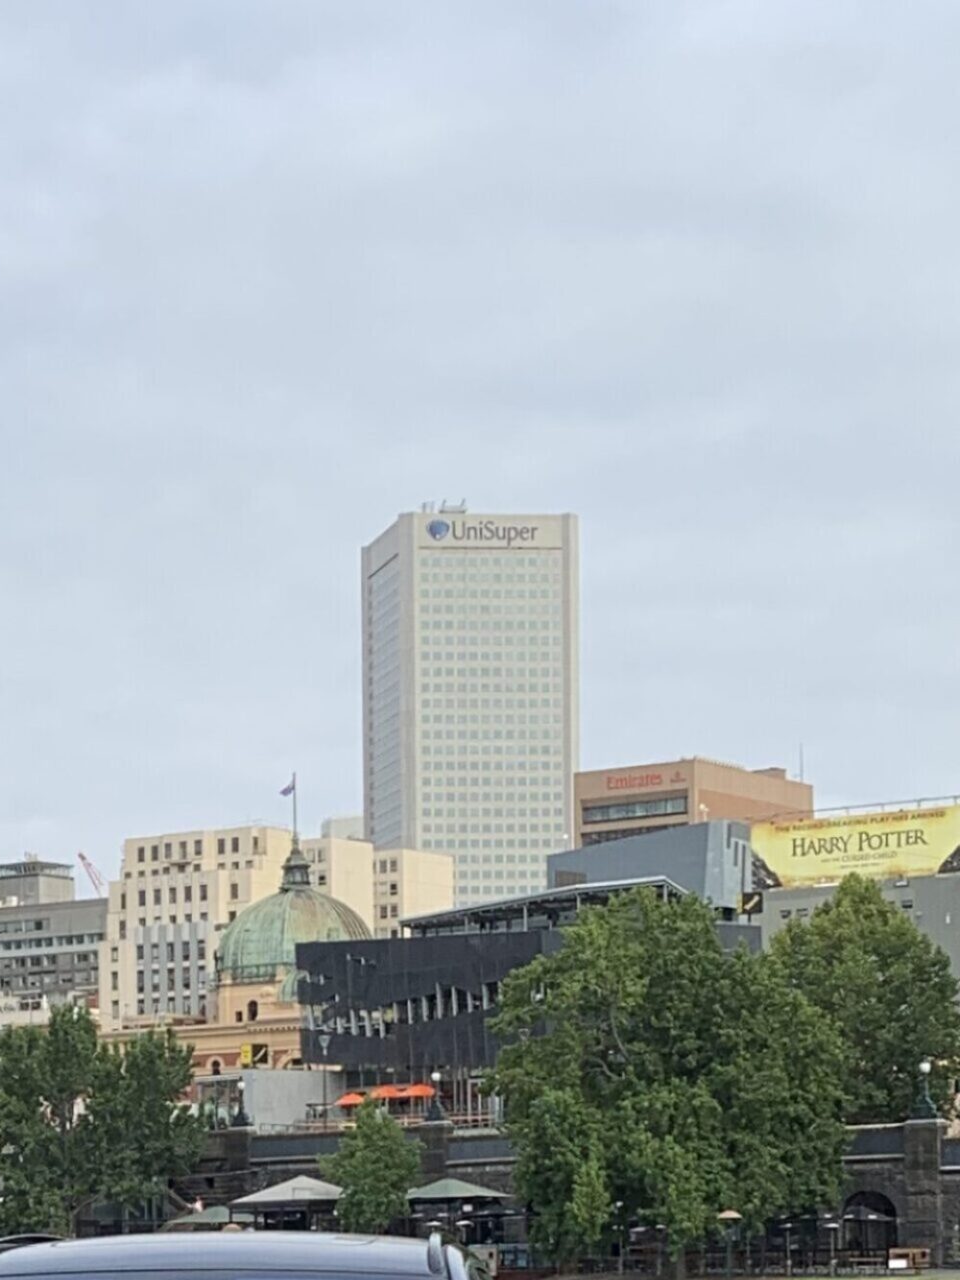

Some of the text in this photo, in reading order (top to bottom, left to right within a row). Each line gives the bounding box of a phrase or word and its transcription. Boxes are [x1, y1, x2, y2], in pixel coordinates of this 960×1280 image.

[451, 520, 539, 547] UniSuper
[607, 774, 663, 790] Emirates
[792, 829, 928, 857] HARRY POTTER
